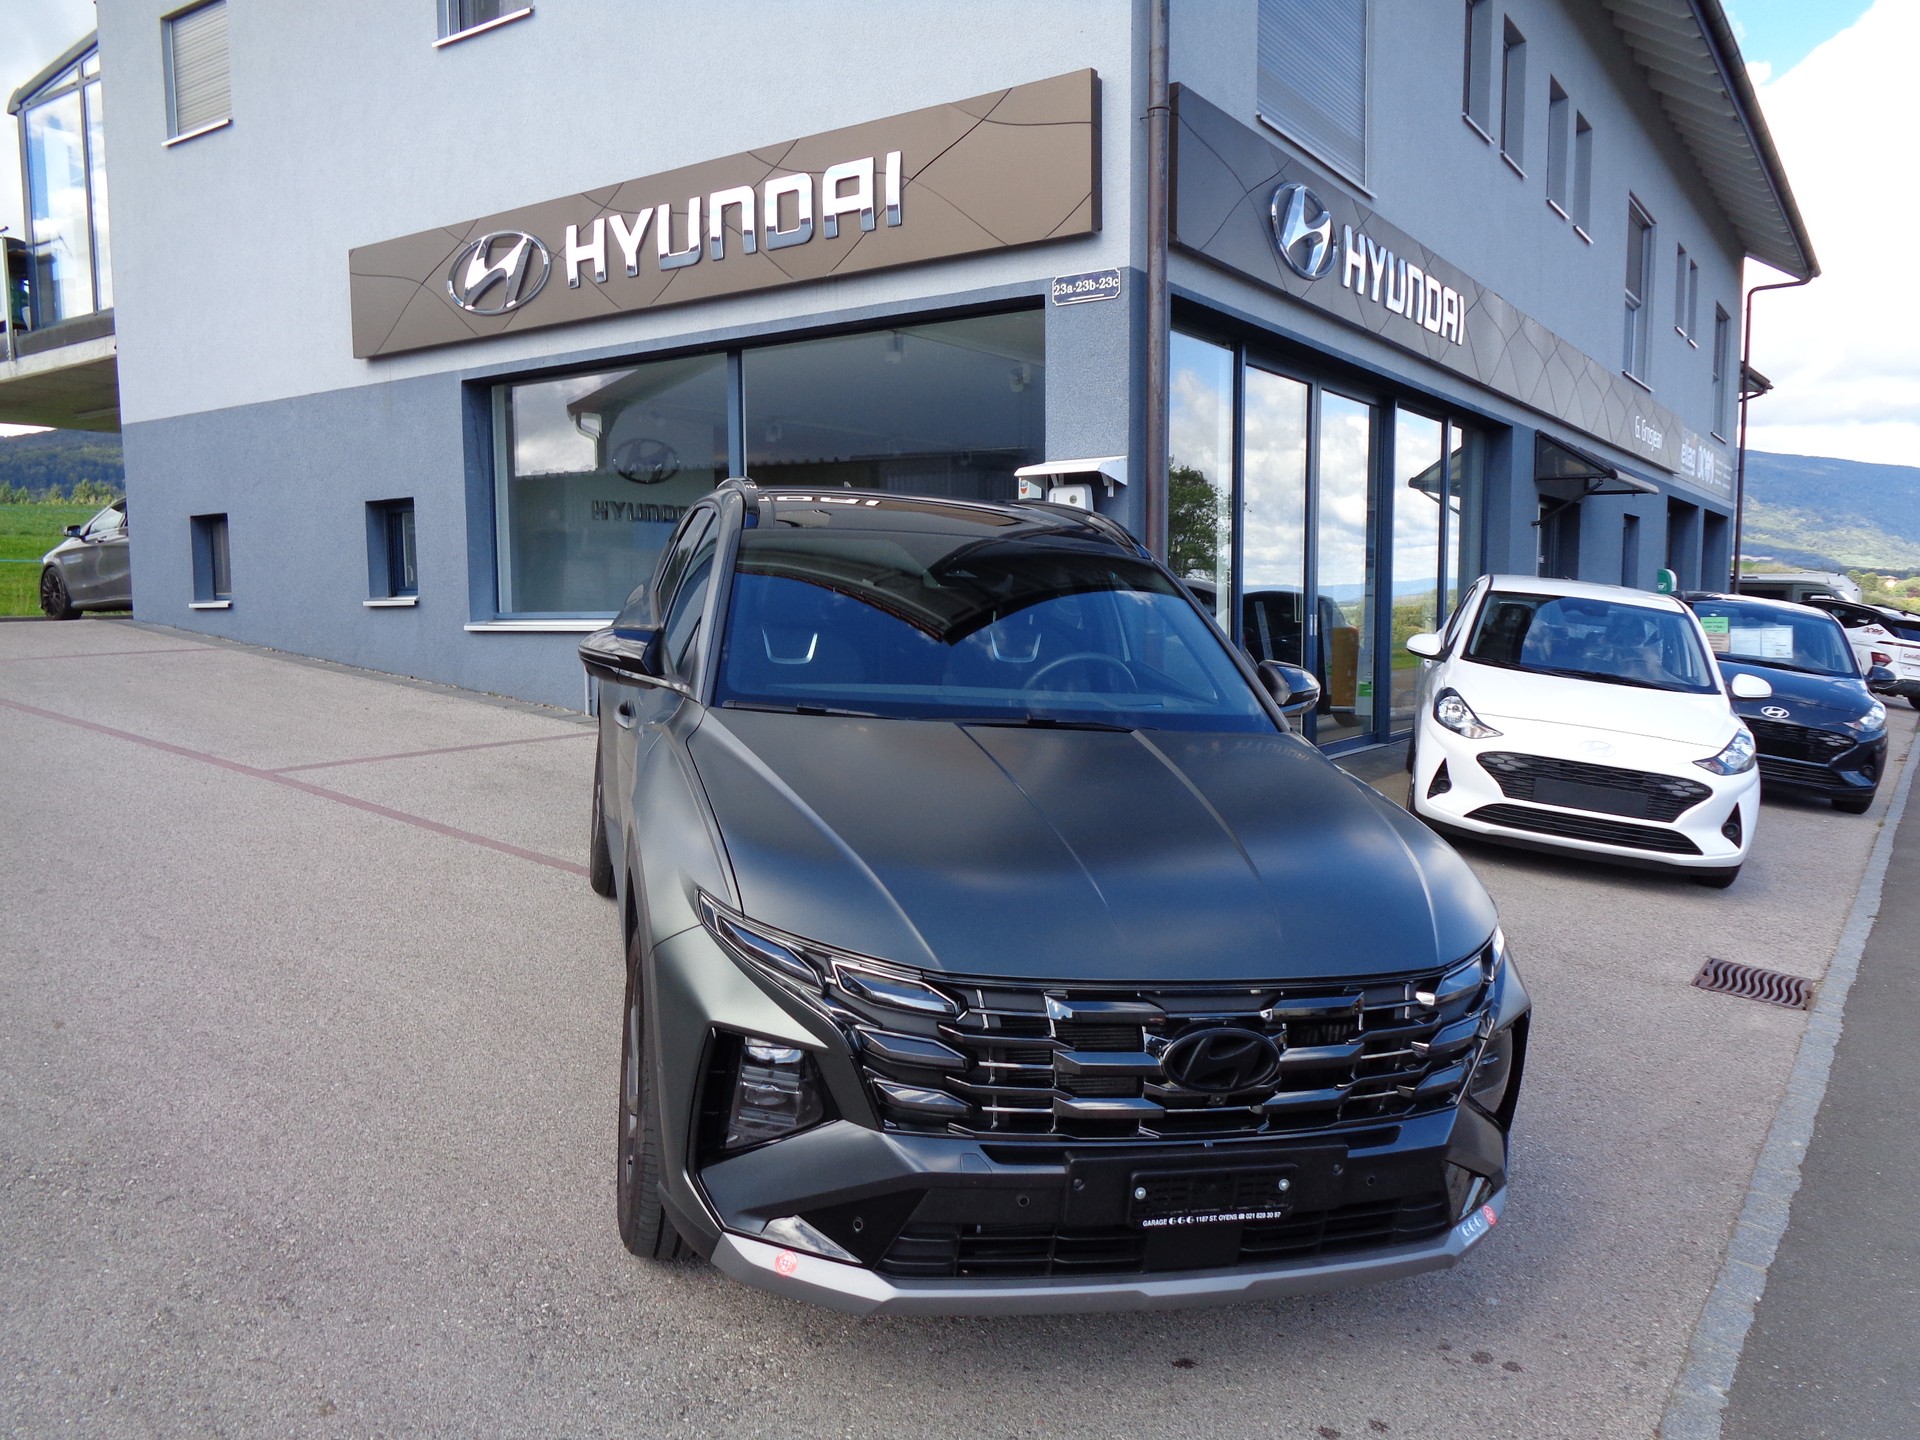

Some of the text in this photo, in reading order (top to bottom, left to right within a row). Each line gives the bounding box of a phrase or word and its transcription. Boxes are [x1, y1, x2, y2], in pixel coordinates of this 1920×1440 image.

[565, 150, 903, 289] HYUNDAI
[1053, 276, 1119, 296] 23a-23b-23c
[1341, 223, 1466, 346] HYUNDAI
[591, 500, 689, 523] HYUND
[1142, 1218, 1168, 1227] GARAGE
